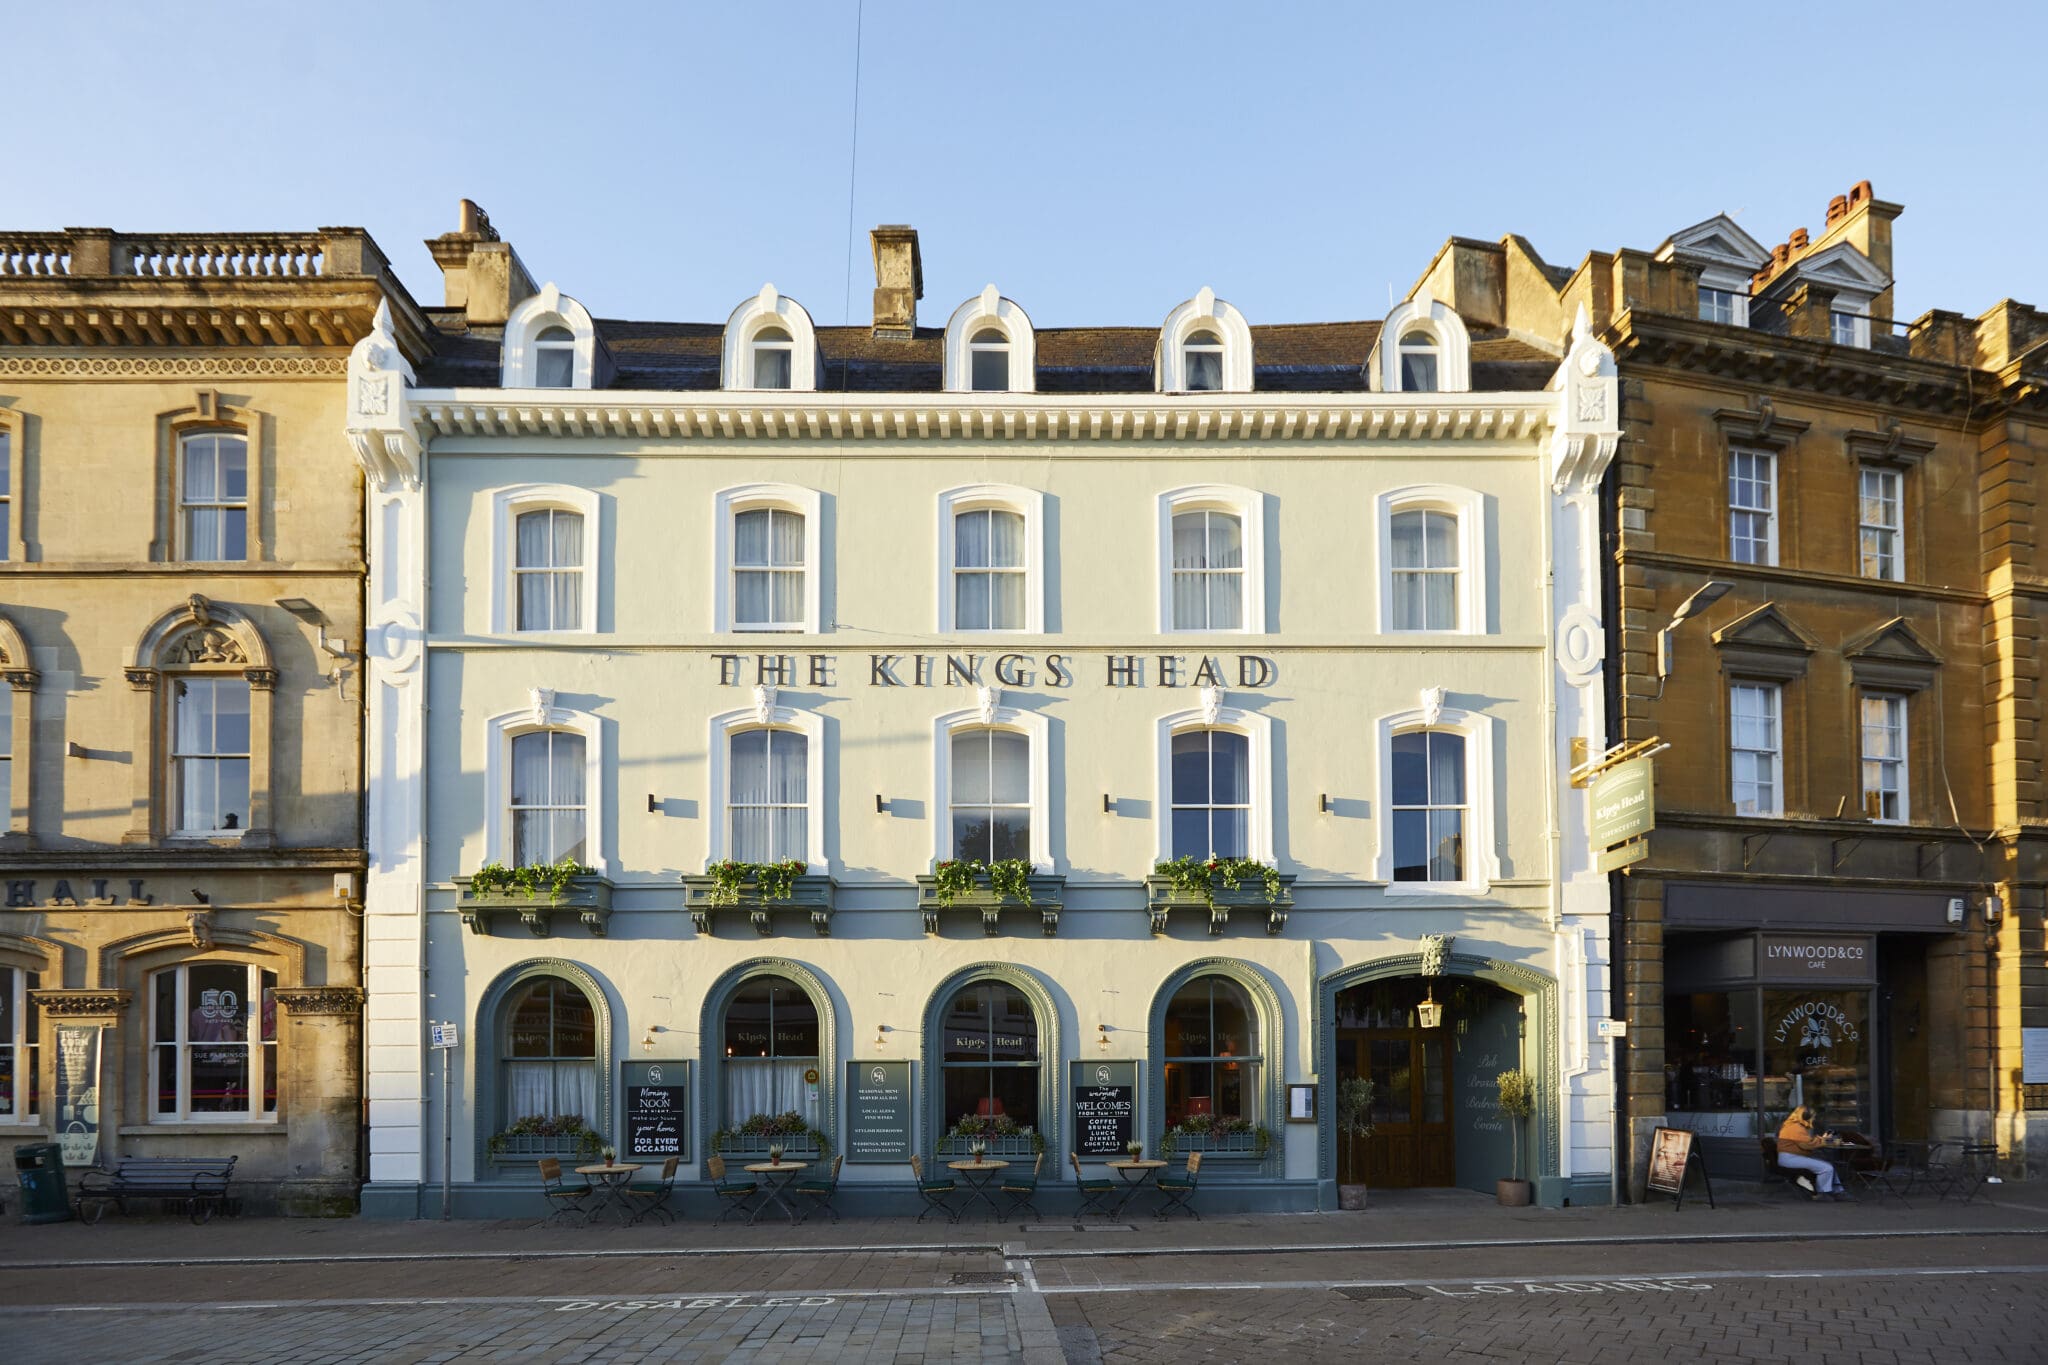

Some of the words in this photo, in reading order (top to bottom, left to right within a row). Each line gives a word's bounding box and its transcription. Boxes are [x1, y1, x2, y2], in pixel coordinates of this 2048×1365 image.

[710, 653, 827, 687] THE
[868, 653, 1065, 688] KINGS
[1104, 653, 1270, 688] HEAD
[1621, 790, 1645, 809] Head
[5, 879, 154, 907] HALL
[60, 1030, 80, 1039] THE
[738, 1032, 767, 1043] Kings
[778, 1032, 803, 1041] Head
[956, 1037, 986, 1048] Kings
[996, 1037, 1022, 1046] Head
[640, 1098, 671, 1108] NOON
[1076, 1101, 1131, 1110] WELCOMES
[634, 1137, 652, 1145] FOR
[655, 1137, 679, 1145] EVERY
[634, 1145, 679, 1153] OCCASION
[1426, 1280, 1714, 1297] LOADING
[555, 1296, 836, 1311] DISABLED
